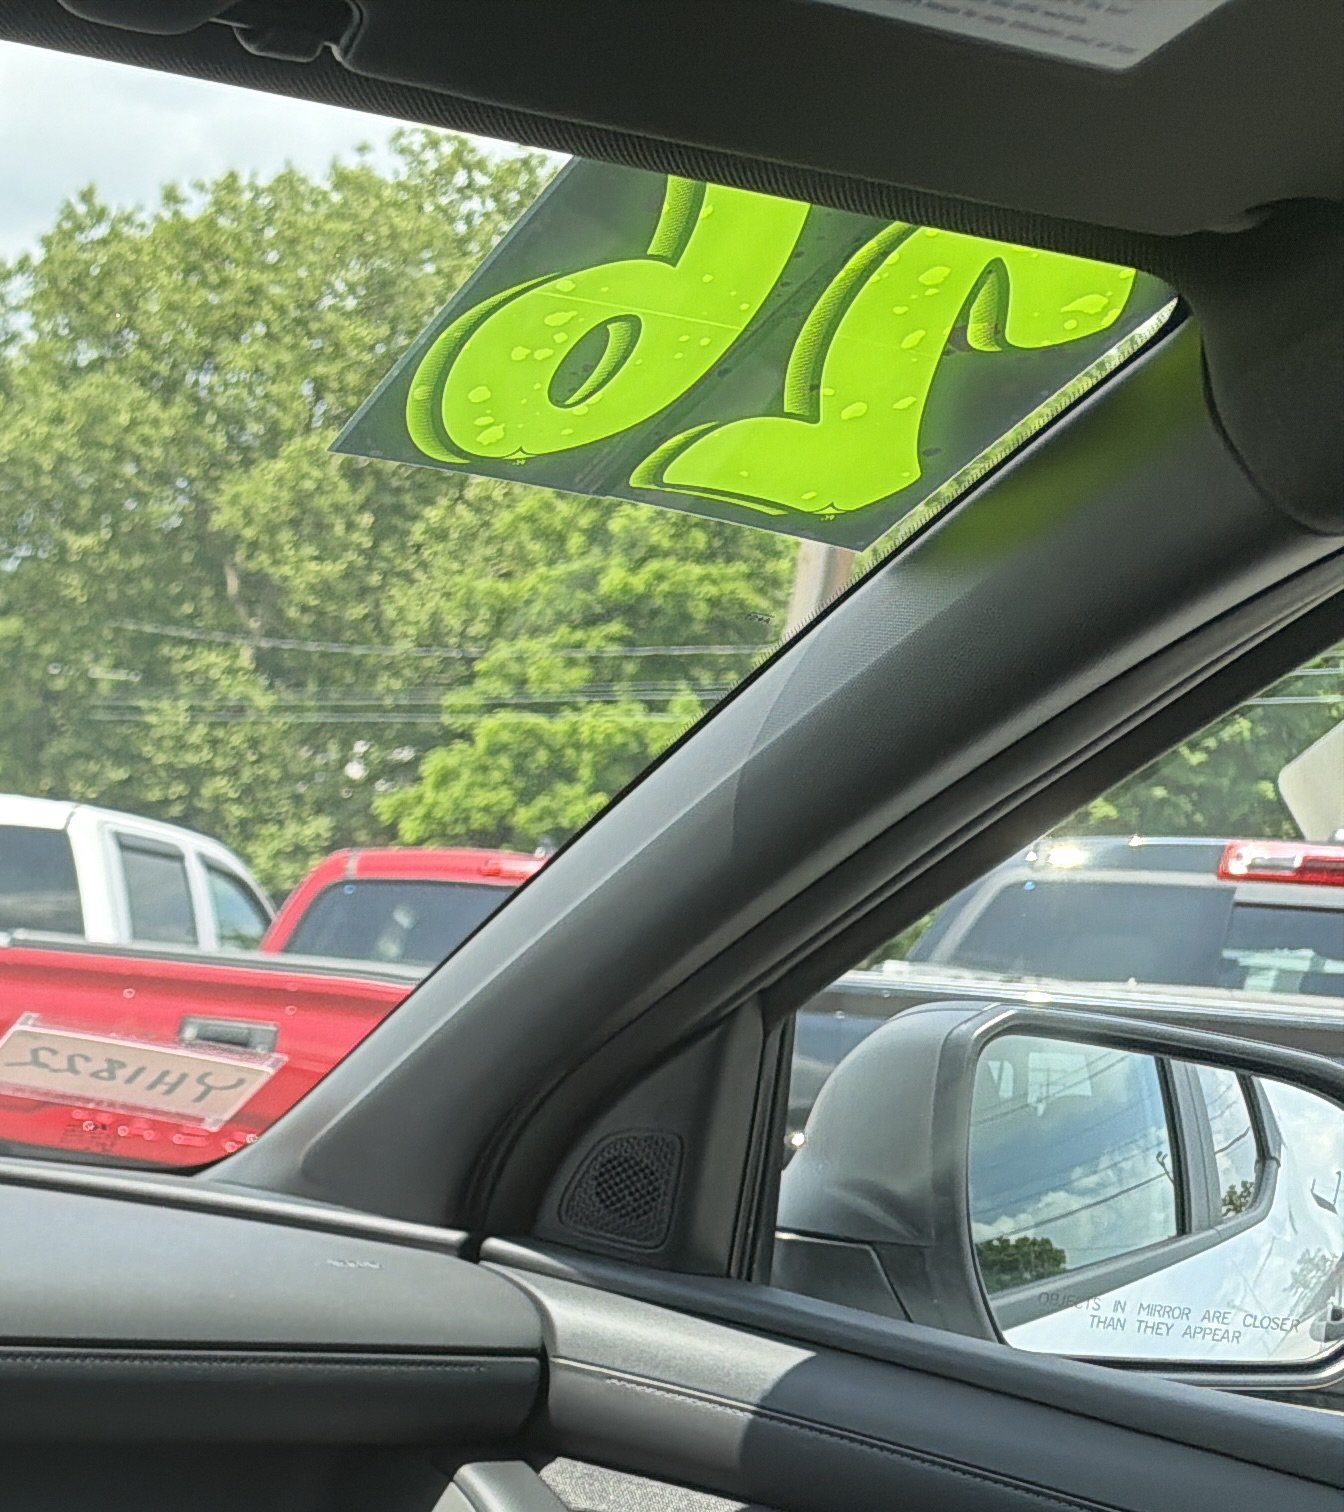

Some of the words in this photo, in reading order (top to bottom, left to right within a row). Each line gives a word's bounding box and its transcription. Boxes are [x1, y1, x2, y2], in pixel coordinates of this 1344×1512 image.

[1037, 1291, 1101, 1312] OBJECTS
[1113, 1299, 1127, 1314] IN
[1138, 1302, 1192, 1322] MIRROR
[1201, 1308, 1232, 1326] ARE
[1242, 1313, 1301, 1333] CLOSER
[1089, 1314, 1127, 1332] THAN
[1136, 1319, 1175, 1337] THEY
[1181, 1325, 1242, 1345] APPEAR
